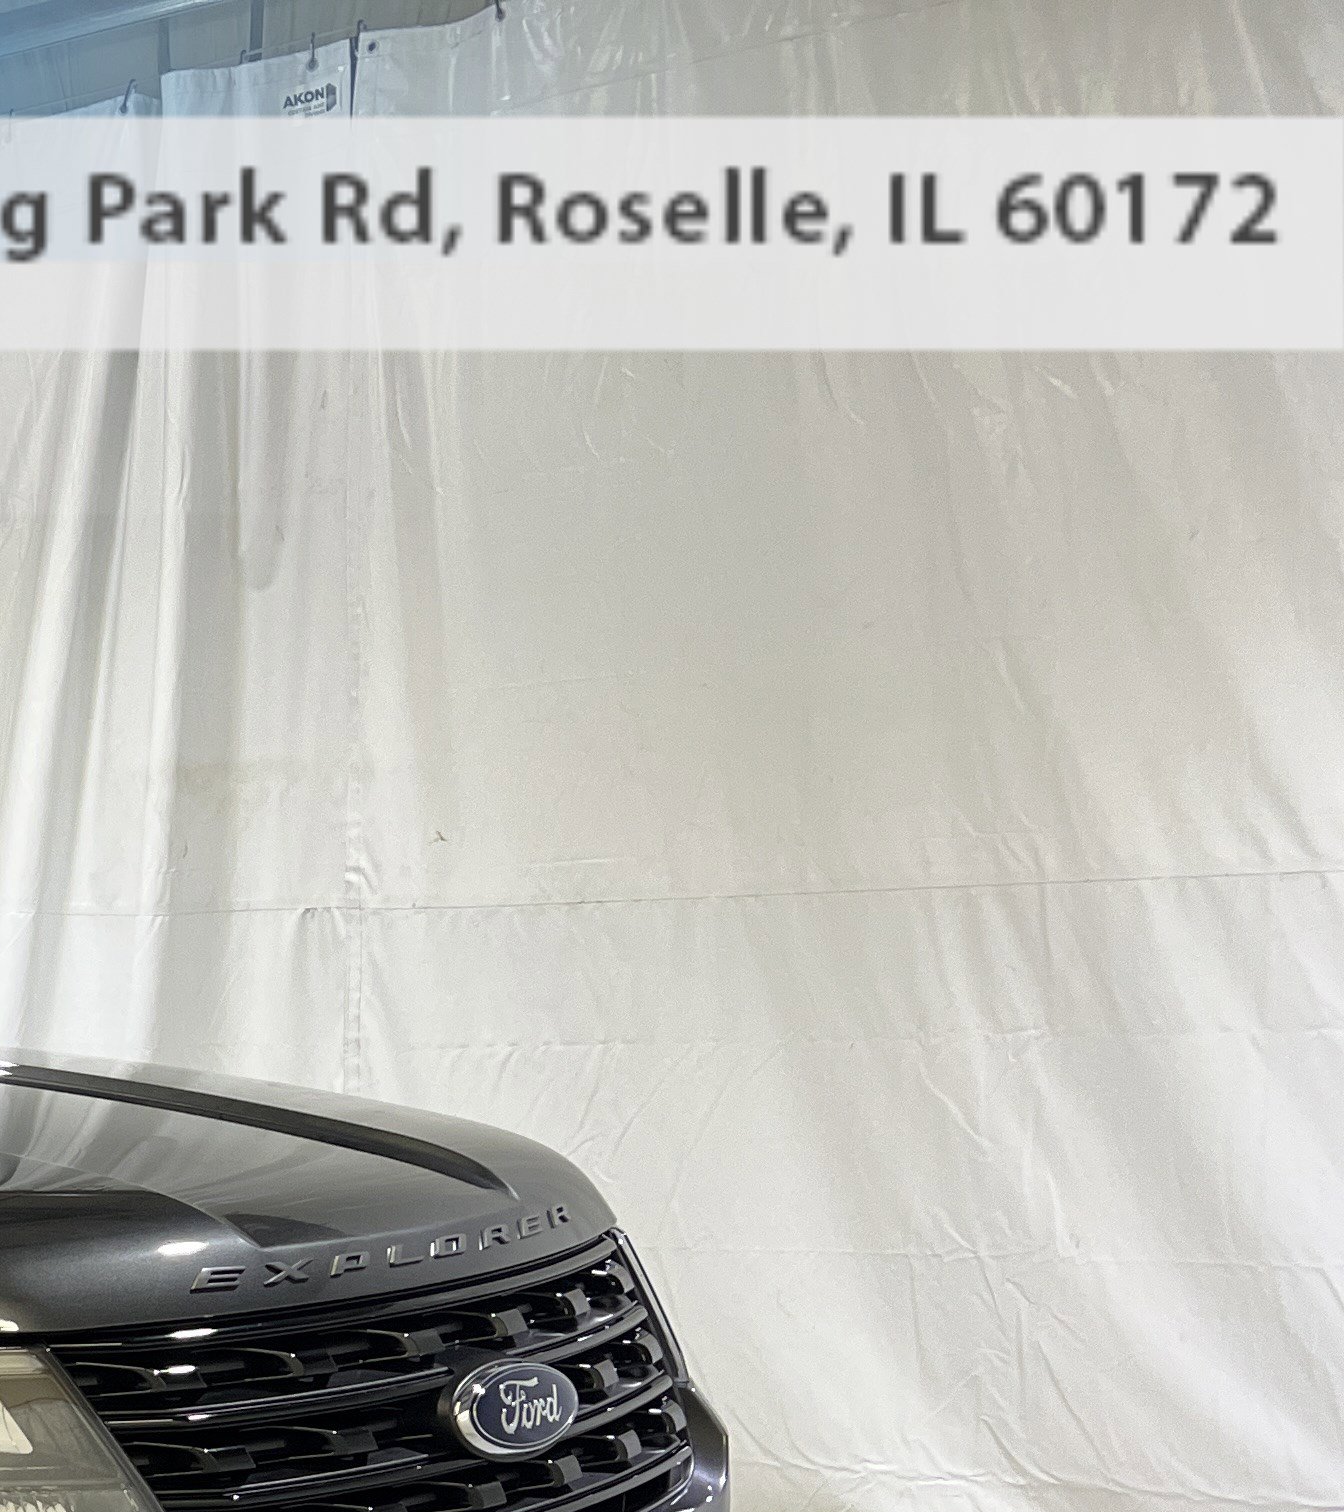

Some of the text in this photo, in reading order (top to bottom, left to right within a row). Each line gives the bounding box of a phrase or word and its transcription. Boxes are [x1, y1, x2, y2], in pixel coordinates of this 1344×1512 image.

[282, 87, 325, 110] AKON
[189, 1203, 572, 1295] EXPLORER
[498, 1376, 564, 1436] Ford
